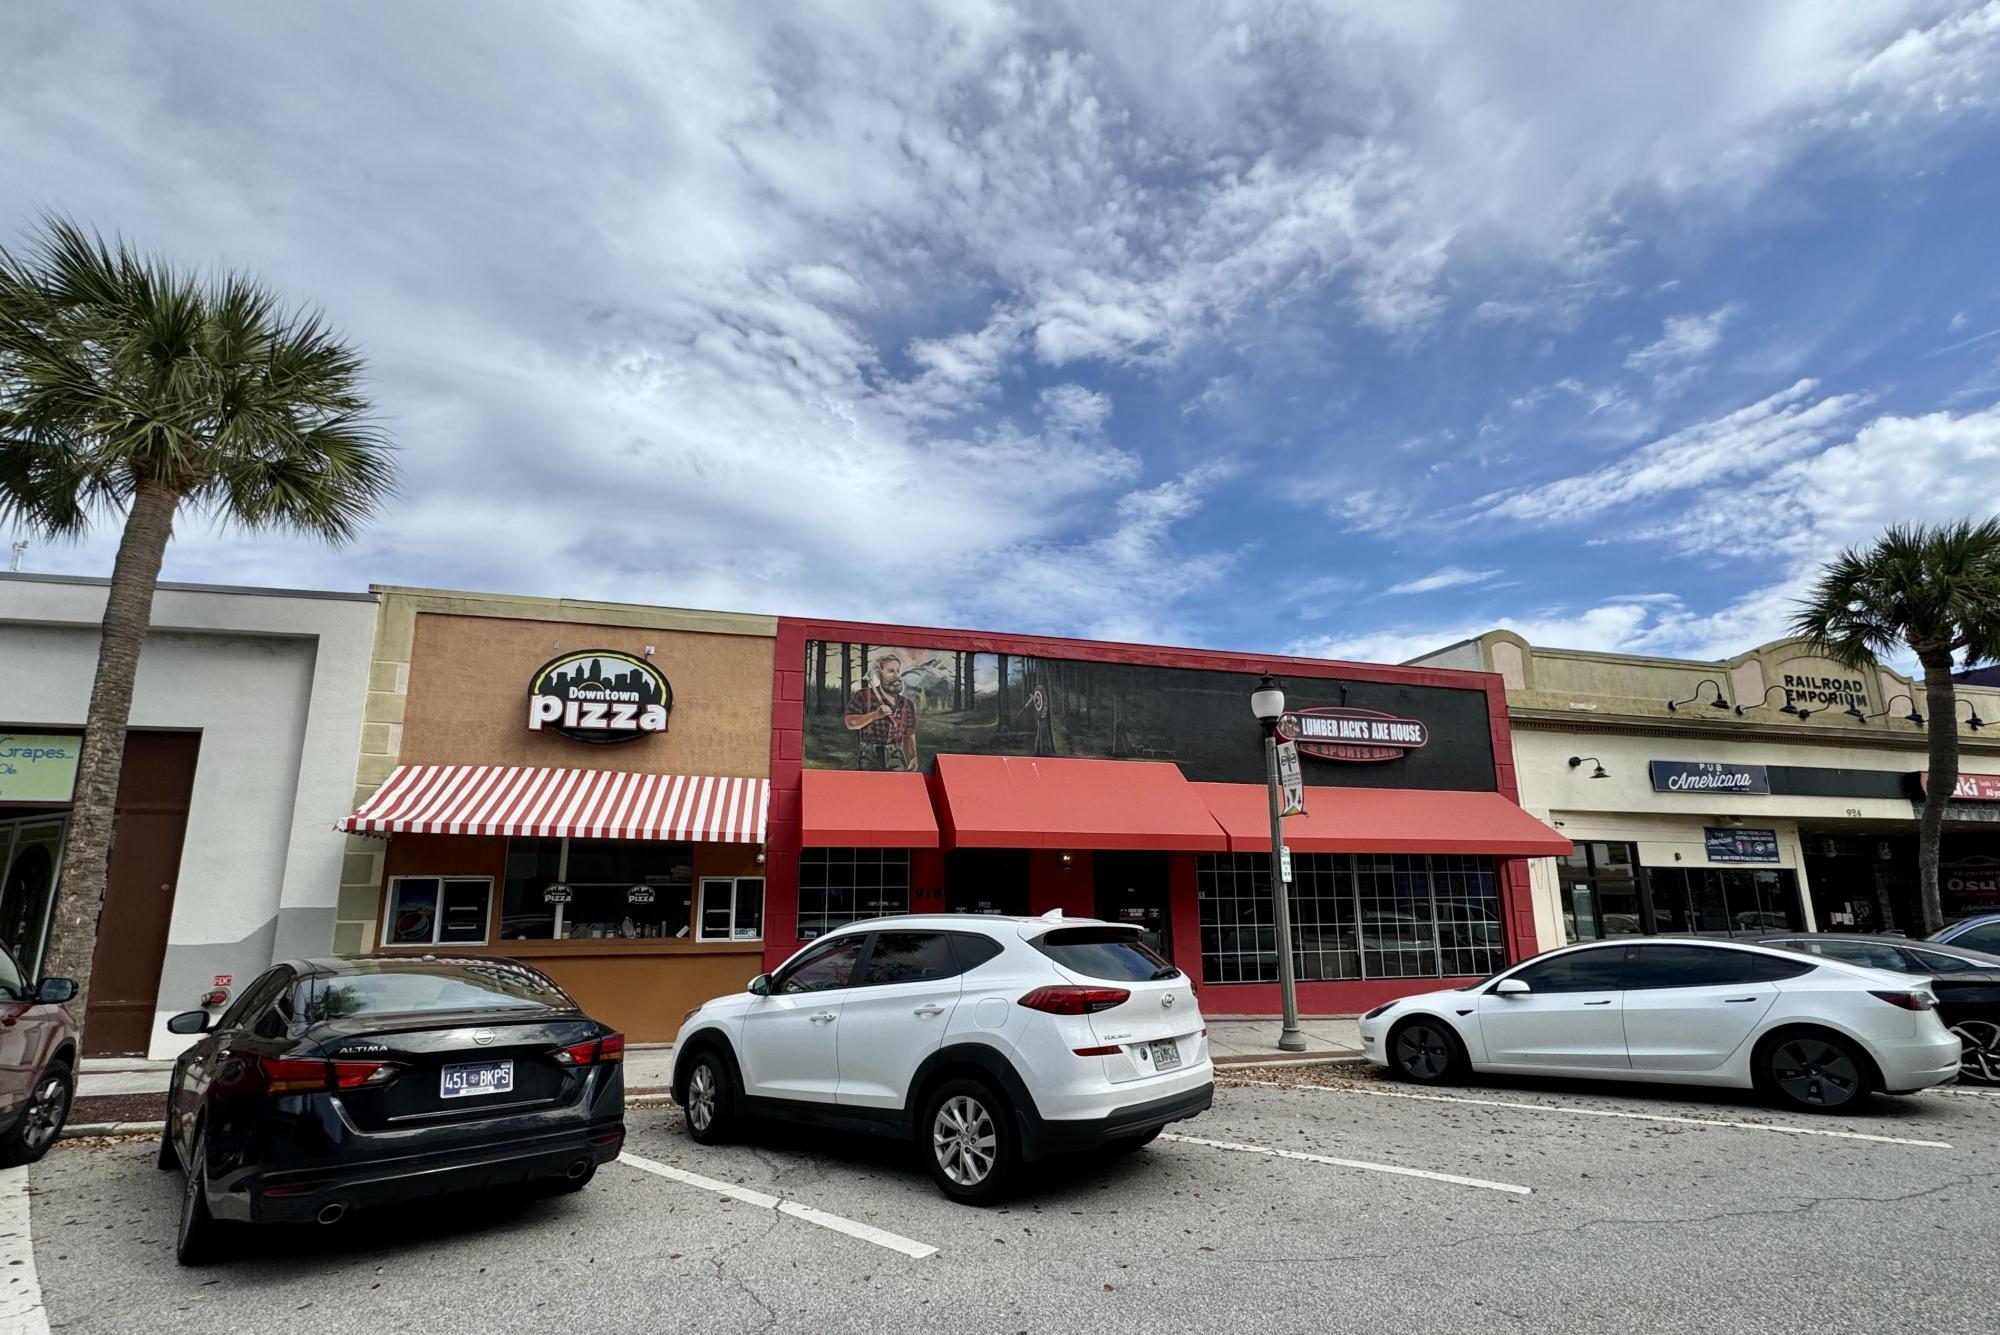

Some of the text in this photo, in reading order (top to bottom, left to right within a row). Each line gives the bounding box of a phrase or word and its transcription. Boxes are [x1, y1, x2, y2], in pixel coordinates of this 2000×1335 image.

[1784, 675, 1862, 692] RAILROAD
[569, 687, 639, 701] Downtown
[1786, 689, 1867, 706] EMPORIUM
[1302, 718, 1421, 741] LUMBER JACK'S AXE HOUSE
[1321, 745, 1370, 758] SPORTS
[1669, 772, 1752, 790] Americana
[339, 1045, 388, 1054] ALTIMA
[445, 1069, 509, 1089] 451 BKPS
